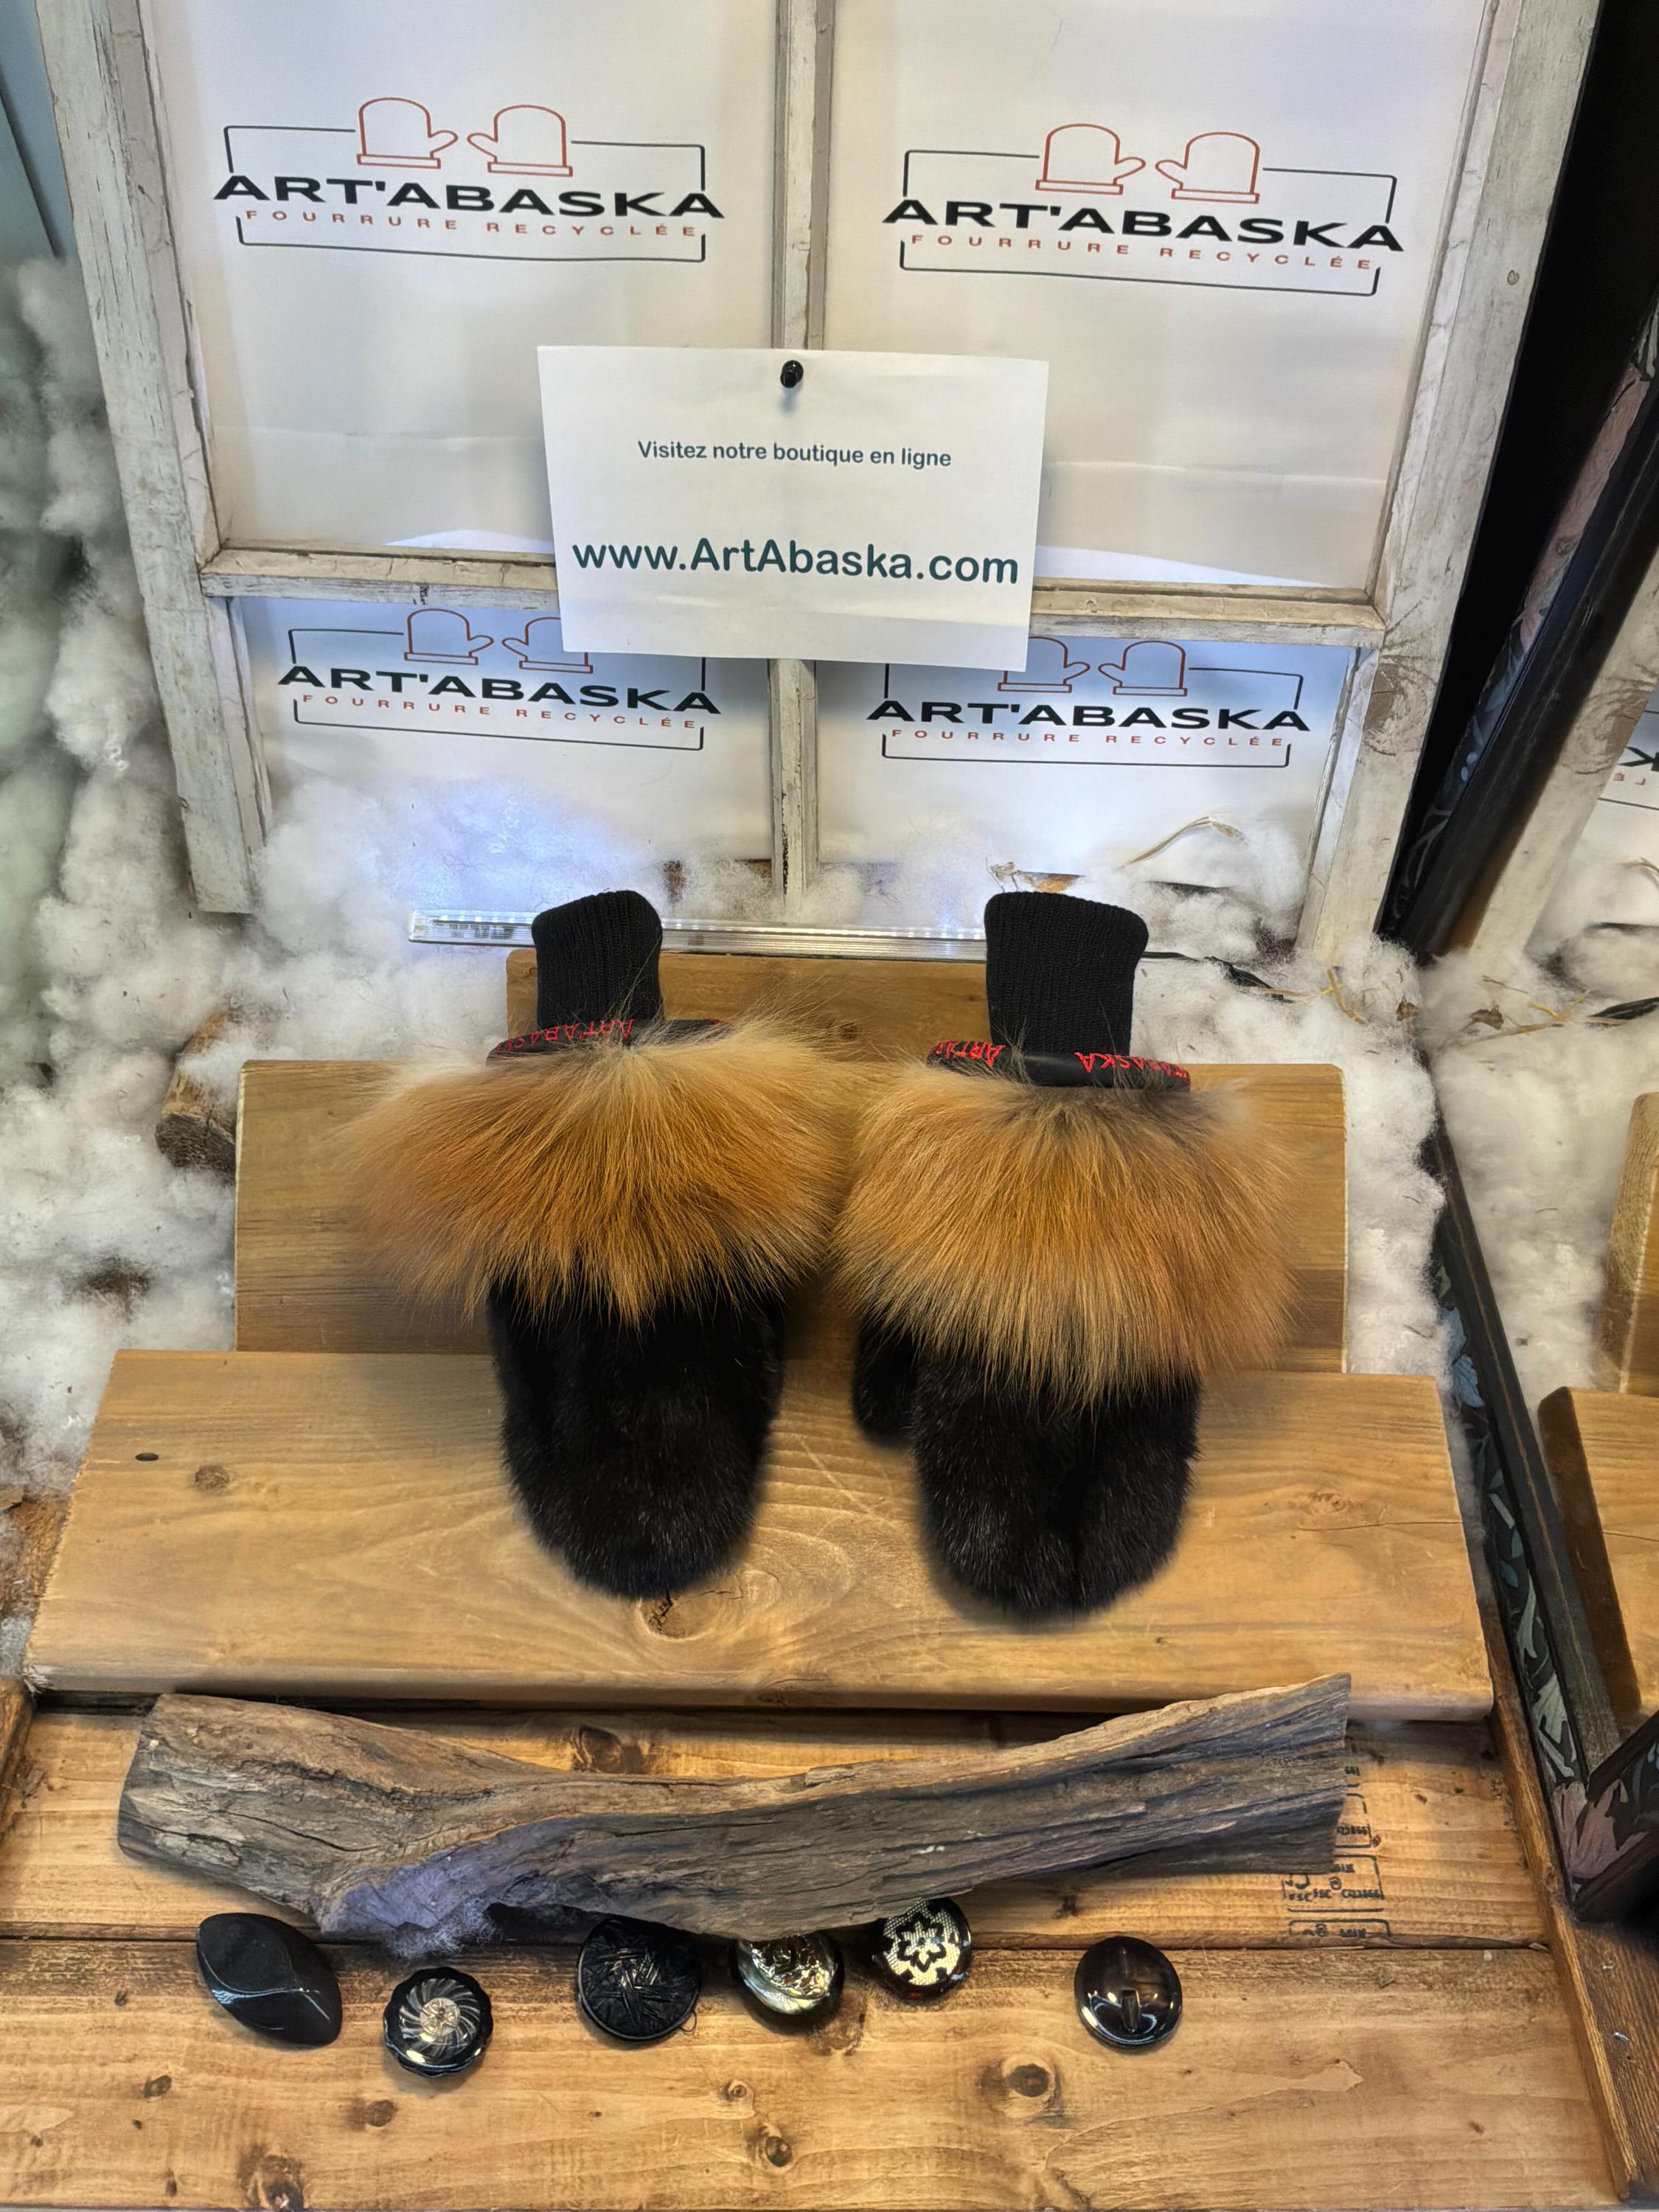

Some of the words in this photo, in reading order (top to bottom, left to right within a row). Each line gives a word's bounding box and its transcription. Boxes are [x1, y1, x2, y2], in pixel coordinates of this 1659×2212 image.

[213, 175, 725, 219] ART'ABASKA
[246, 209, 459, 230] FOURRURE
[486, 223, 695, 237] RECYCLÉE
[883, 199, 1404, 252] ART'ABASKA
[911, 234, 1130, 255] FOURRURE
[1158, 247, 1371, 270] RECYCLÉE
[638, 440, 708, 459] Visitez
[713, 442, 767, 460] notre
[773, 442, 864, 467] boutique
[870, 451, 894, 465] en
[901, 448, 951, 470] ligne
[572, 538, 1018, 584] www.ArtAbaska.com
[277, 665, 722, 714] ART'ABASKA
[302, 695, 490, 714] FOURRURE
[515, 708, 695, 728] RECYCLÉE
[866, 700, 1310, 731] ART'ABASKA
[891, 728, 1079, 742] FOURRURE
[1106, 734, 1283, 746] RECYCLÉE
